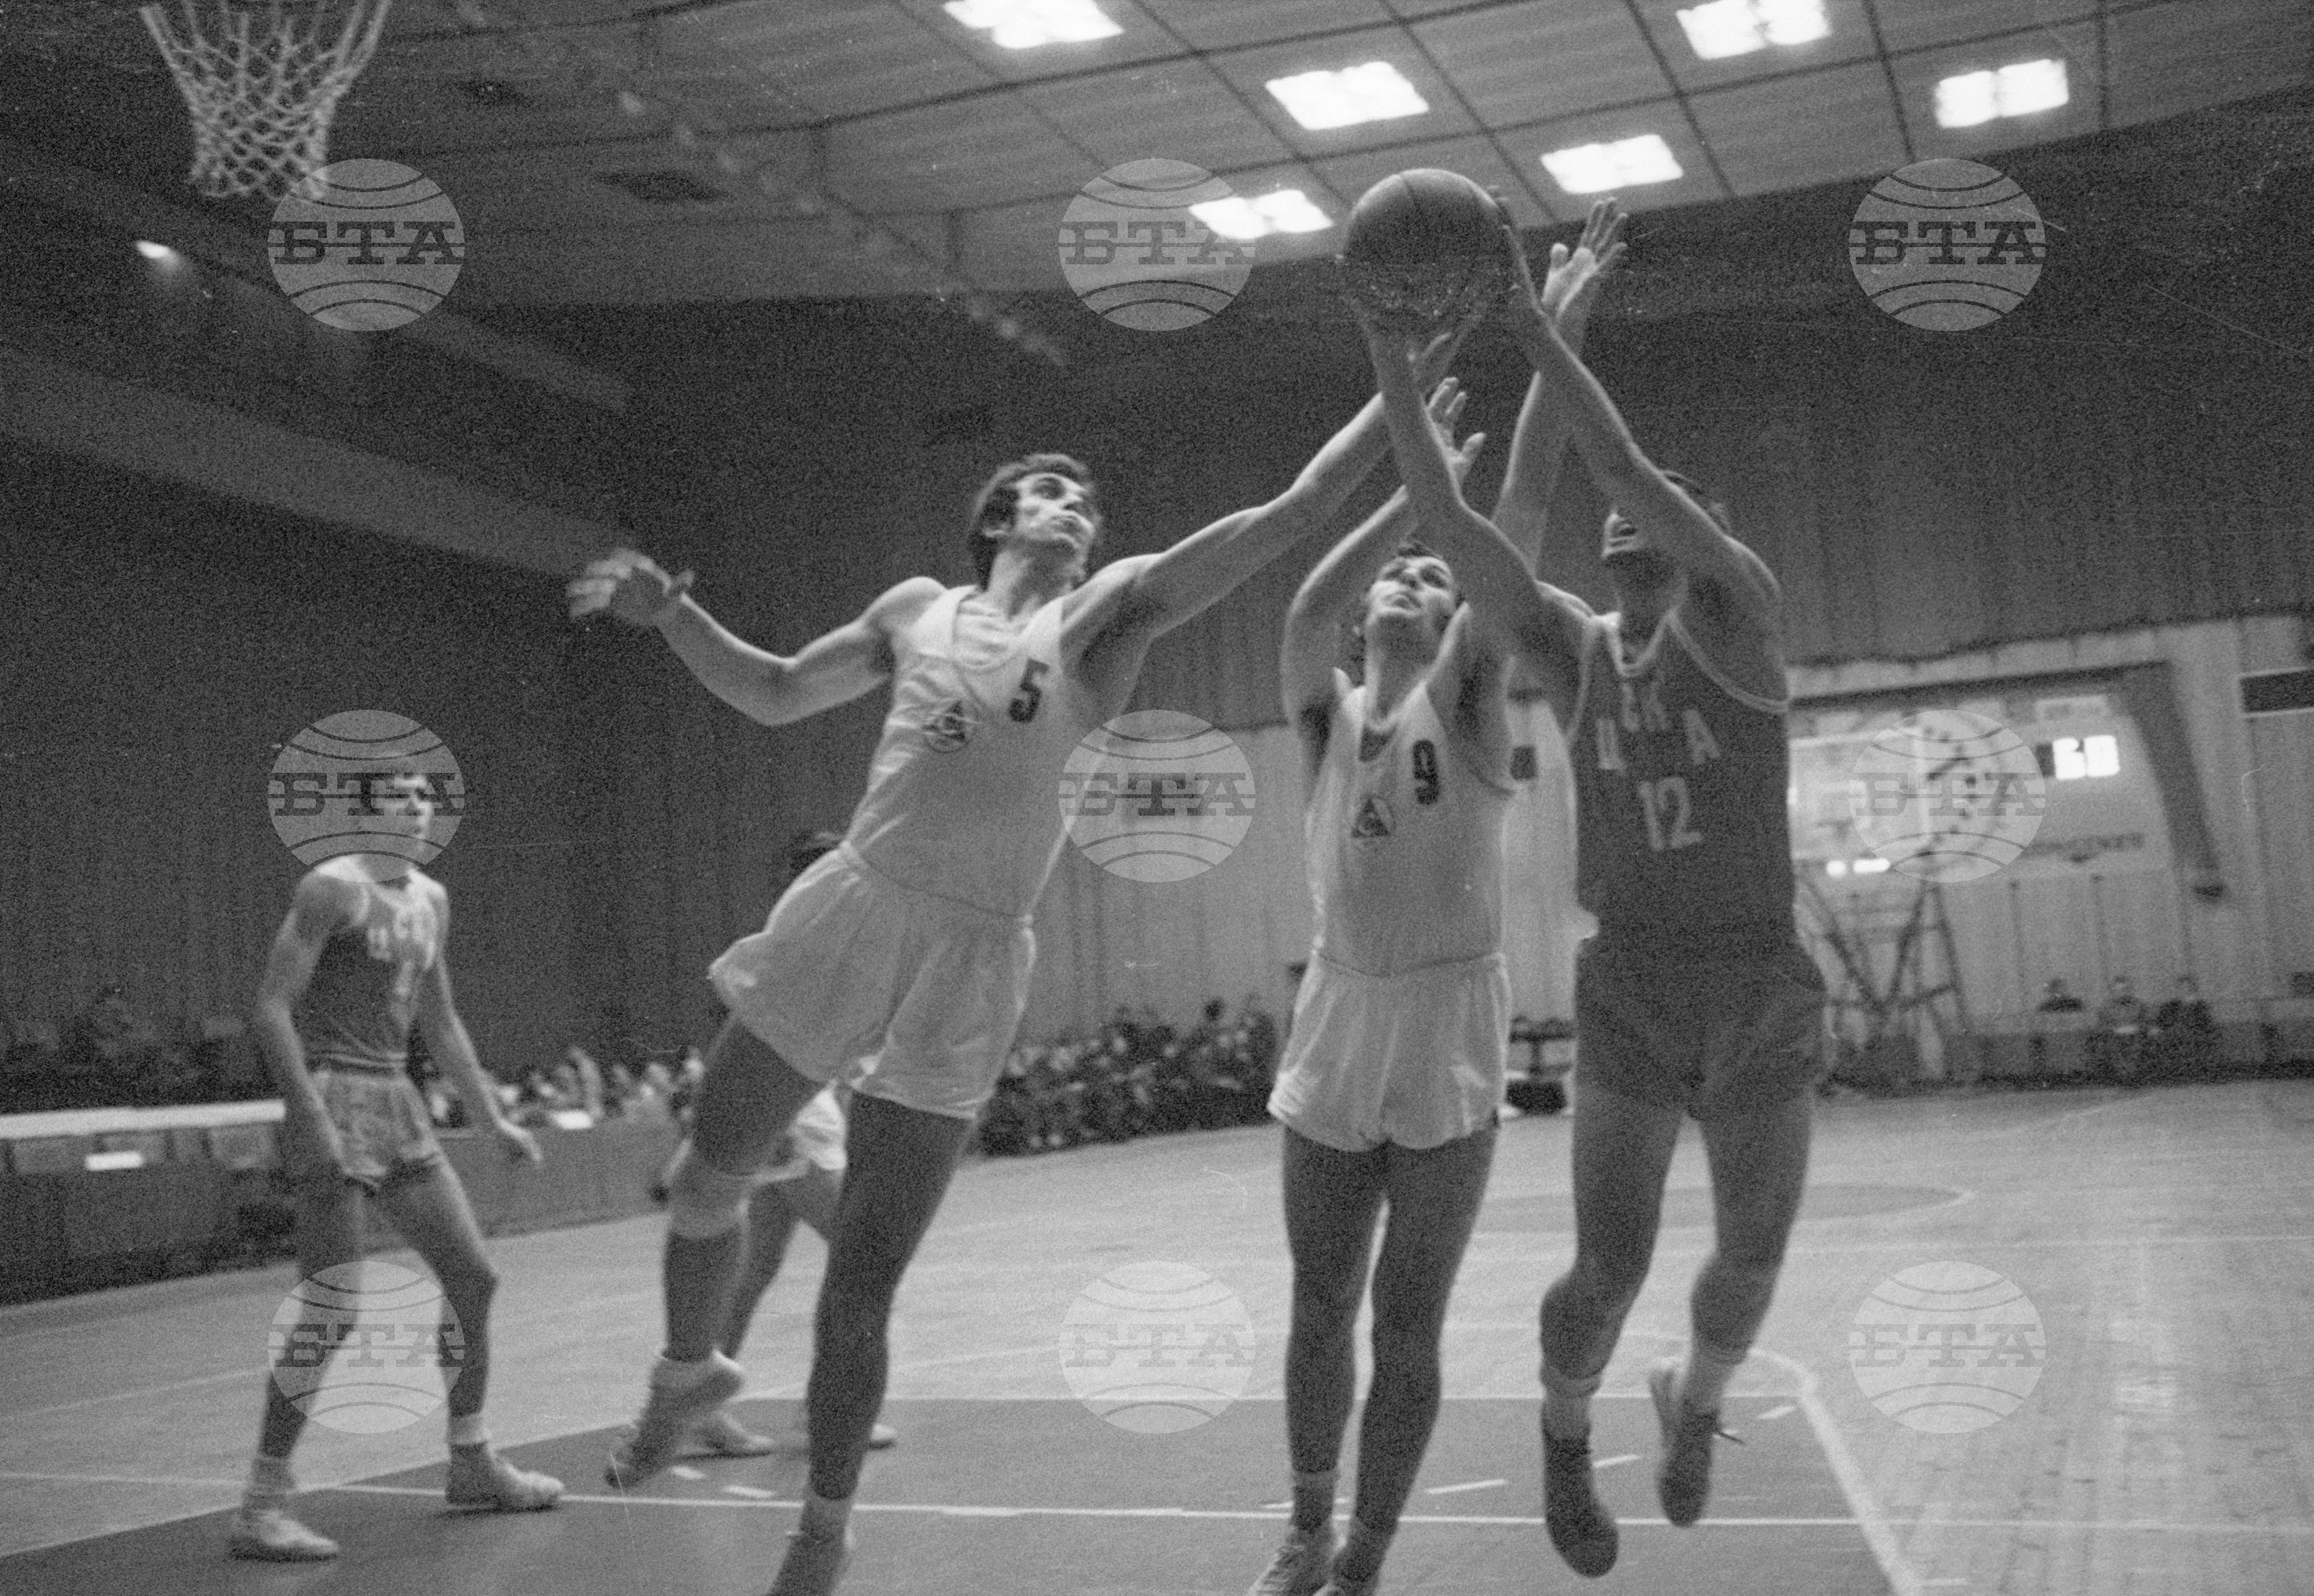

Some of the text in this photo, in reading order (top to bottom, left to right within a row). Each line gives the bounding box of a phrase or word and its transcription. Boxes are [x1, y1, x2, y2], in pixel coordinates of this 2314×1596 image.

[1008, 658, 1049, 723] 5
[1413, 739, 1440, 805] 9
[1638, 776, 1704, 851] 12
